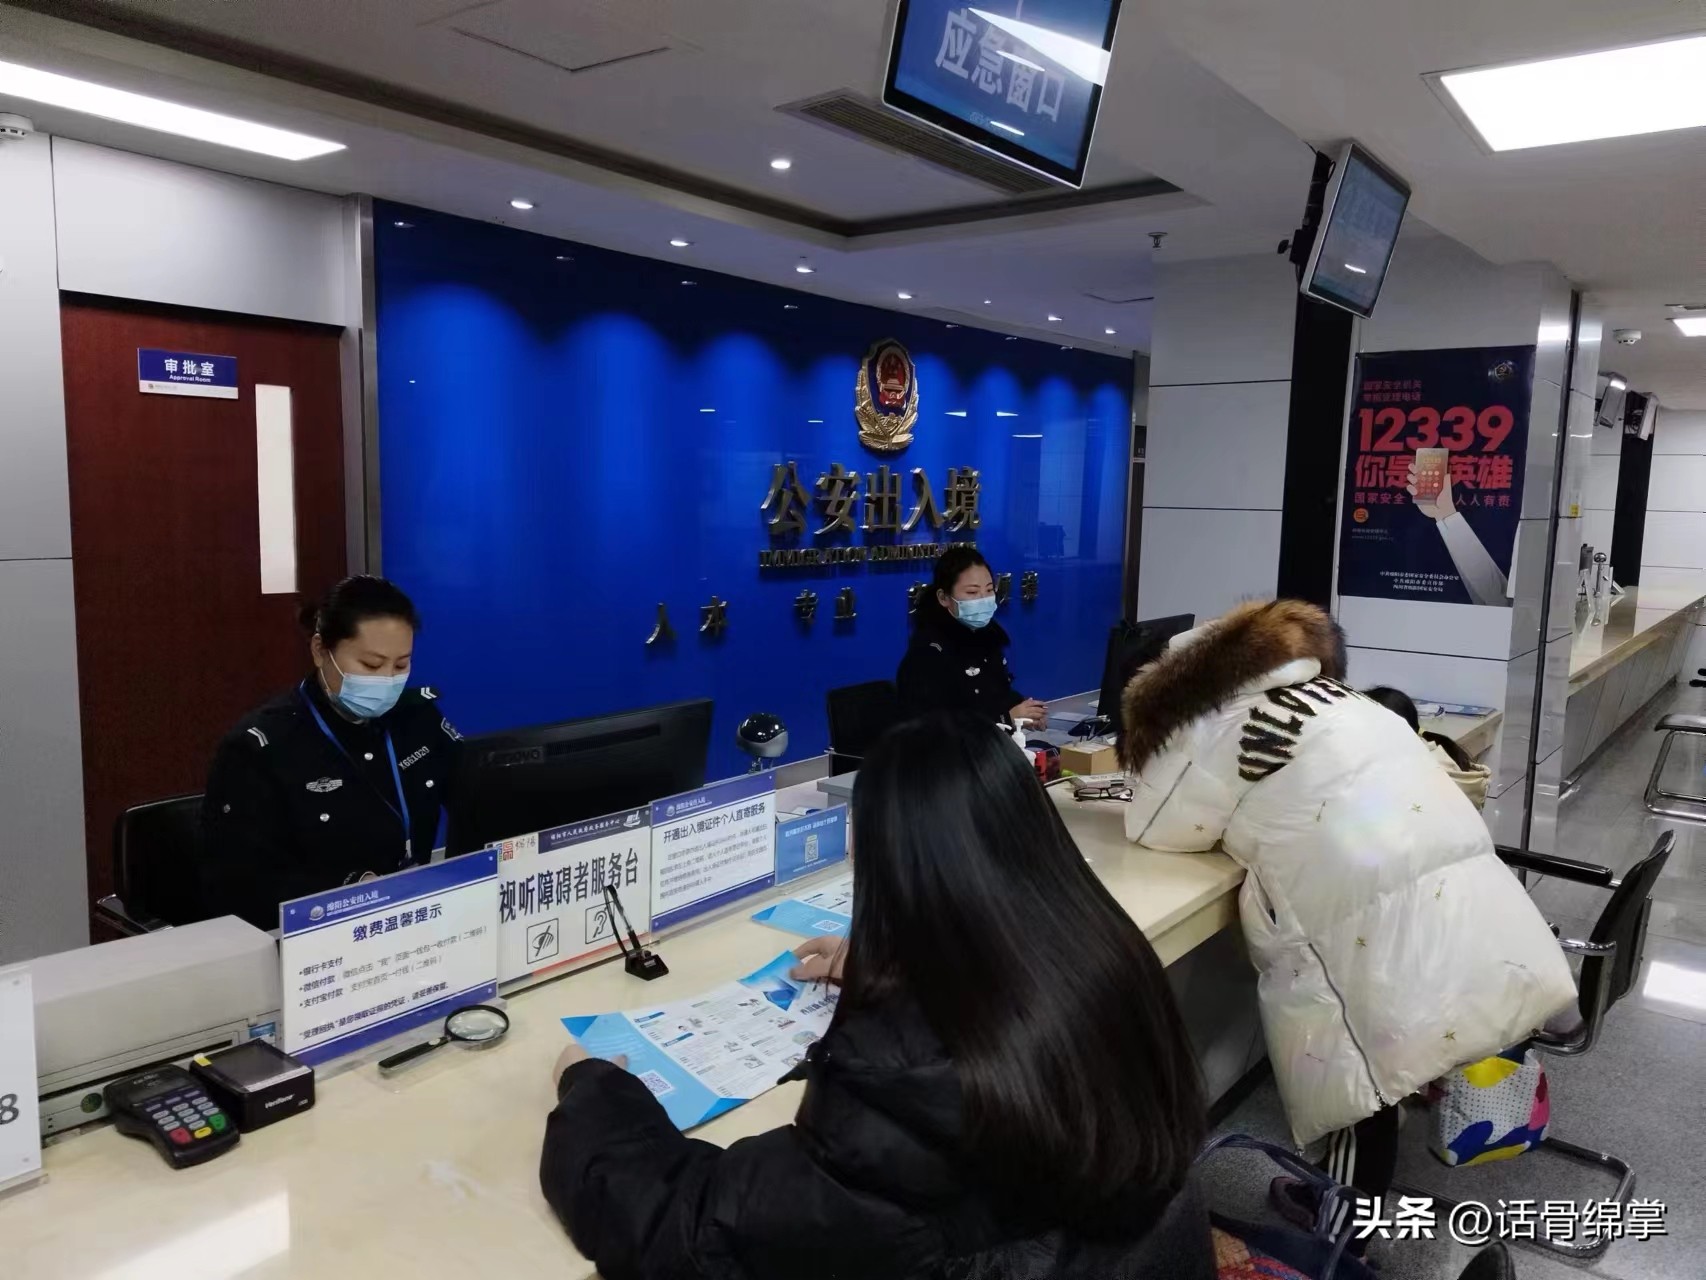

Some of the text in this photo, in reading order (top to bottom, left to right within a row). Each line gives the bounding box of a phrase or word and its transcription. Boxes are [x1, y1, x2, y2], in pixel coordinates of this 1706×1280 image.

[936, 8, 1064, 122] 应急窗口
[164, 358, 215, 377] 审批室
[169, 374, 195, 382] Approval
[1359, 405, 1514, 452] 12339
[1449, 454, 1513, 489] 英雄
[760, 461, 981, 534] 公安出入境
[1354, 492, 1512, 508] 国家安全 人人有责
[499, 848, 638, 924] 视听障碍者服务台
[353, 903, 442, 943] 缴费温馨提示
